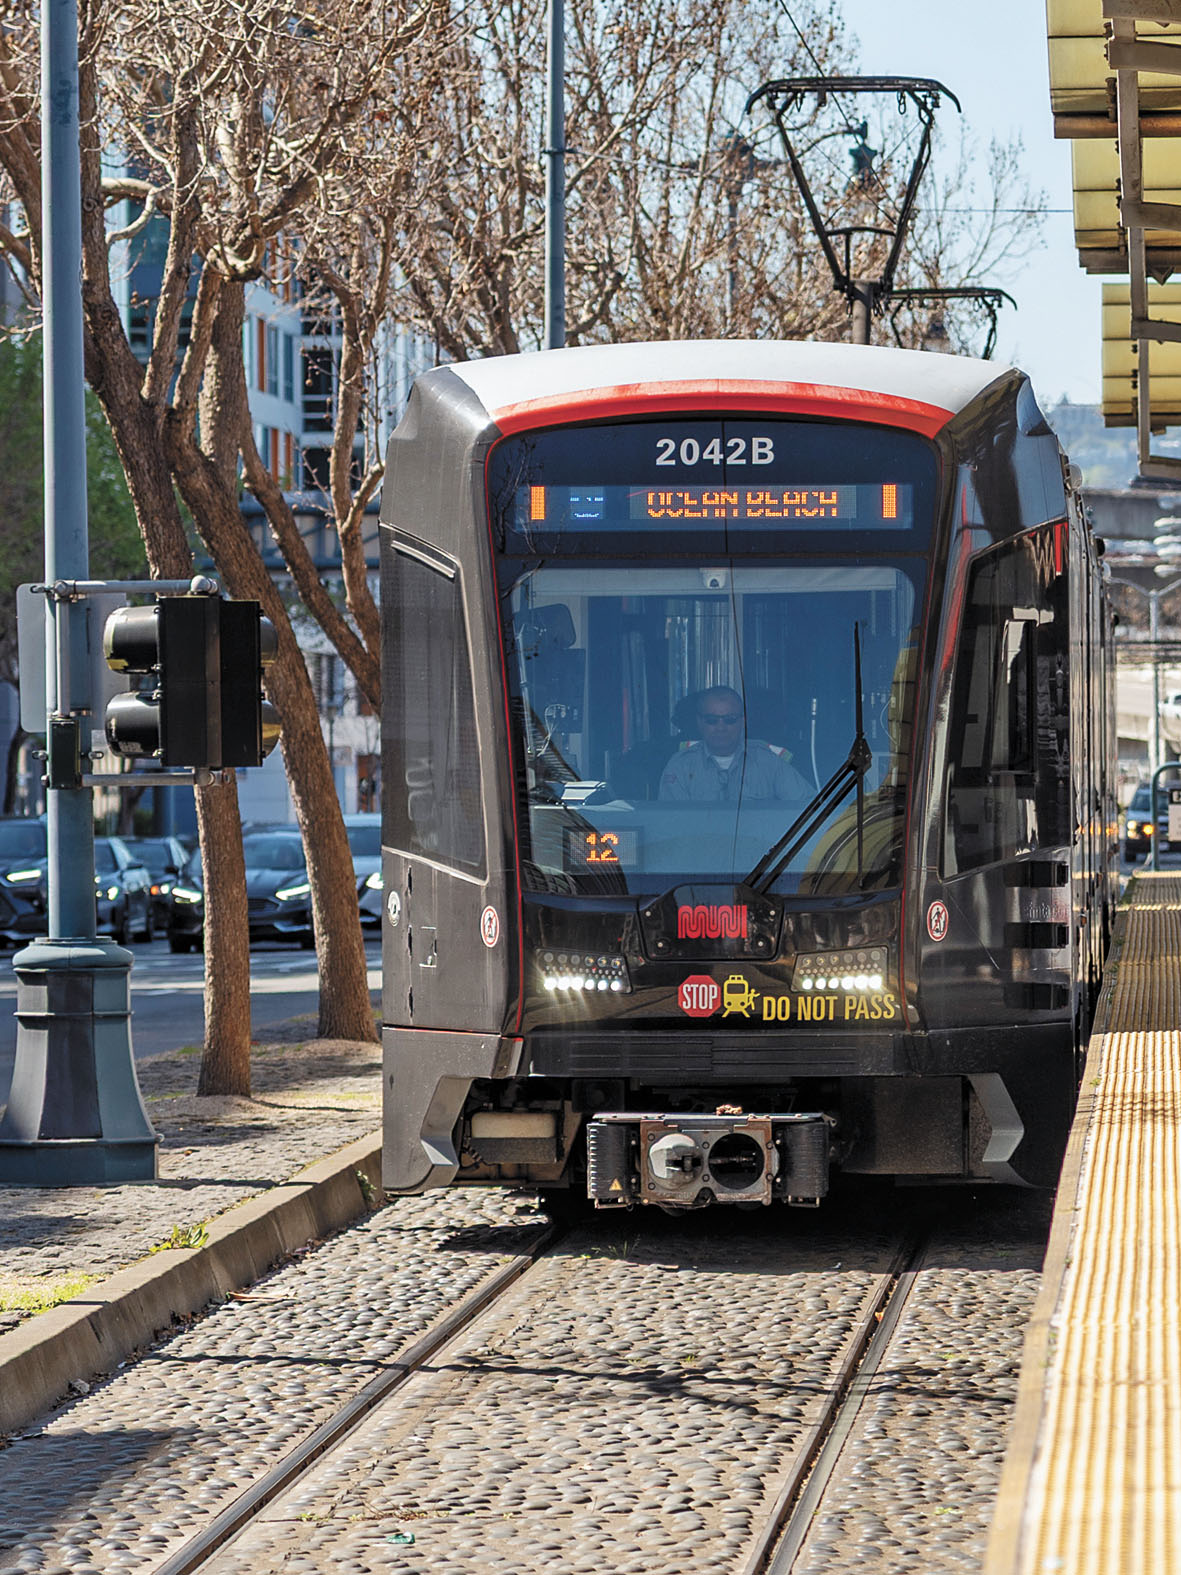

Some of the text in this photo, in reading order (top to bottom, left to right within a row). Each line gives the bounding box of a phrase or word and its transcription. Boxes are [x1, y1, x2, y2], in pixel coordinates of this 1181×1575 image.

[656, 437, 775, 466] 2042B
[648, 491, 837, 518] OCEAN BEACH
[586, 832, 619, 862] 12
[682, 982, 718, 1010] STOP
[762, 993, 896, 1022] DO NOT PASS
